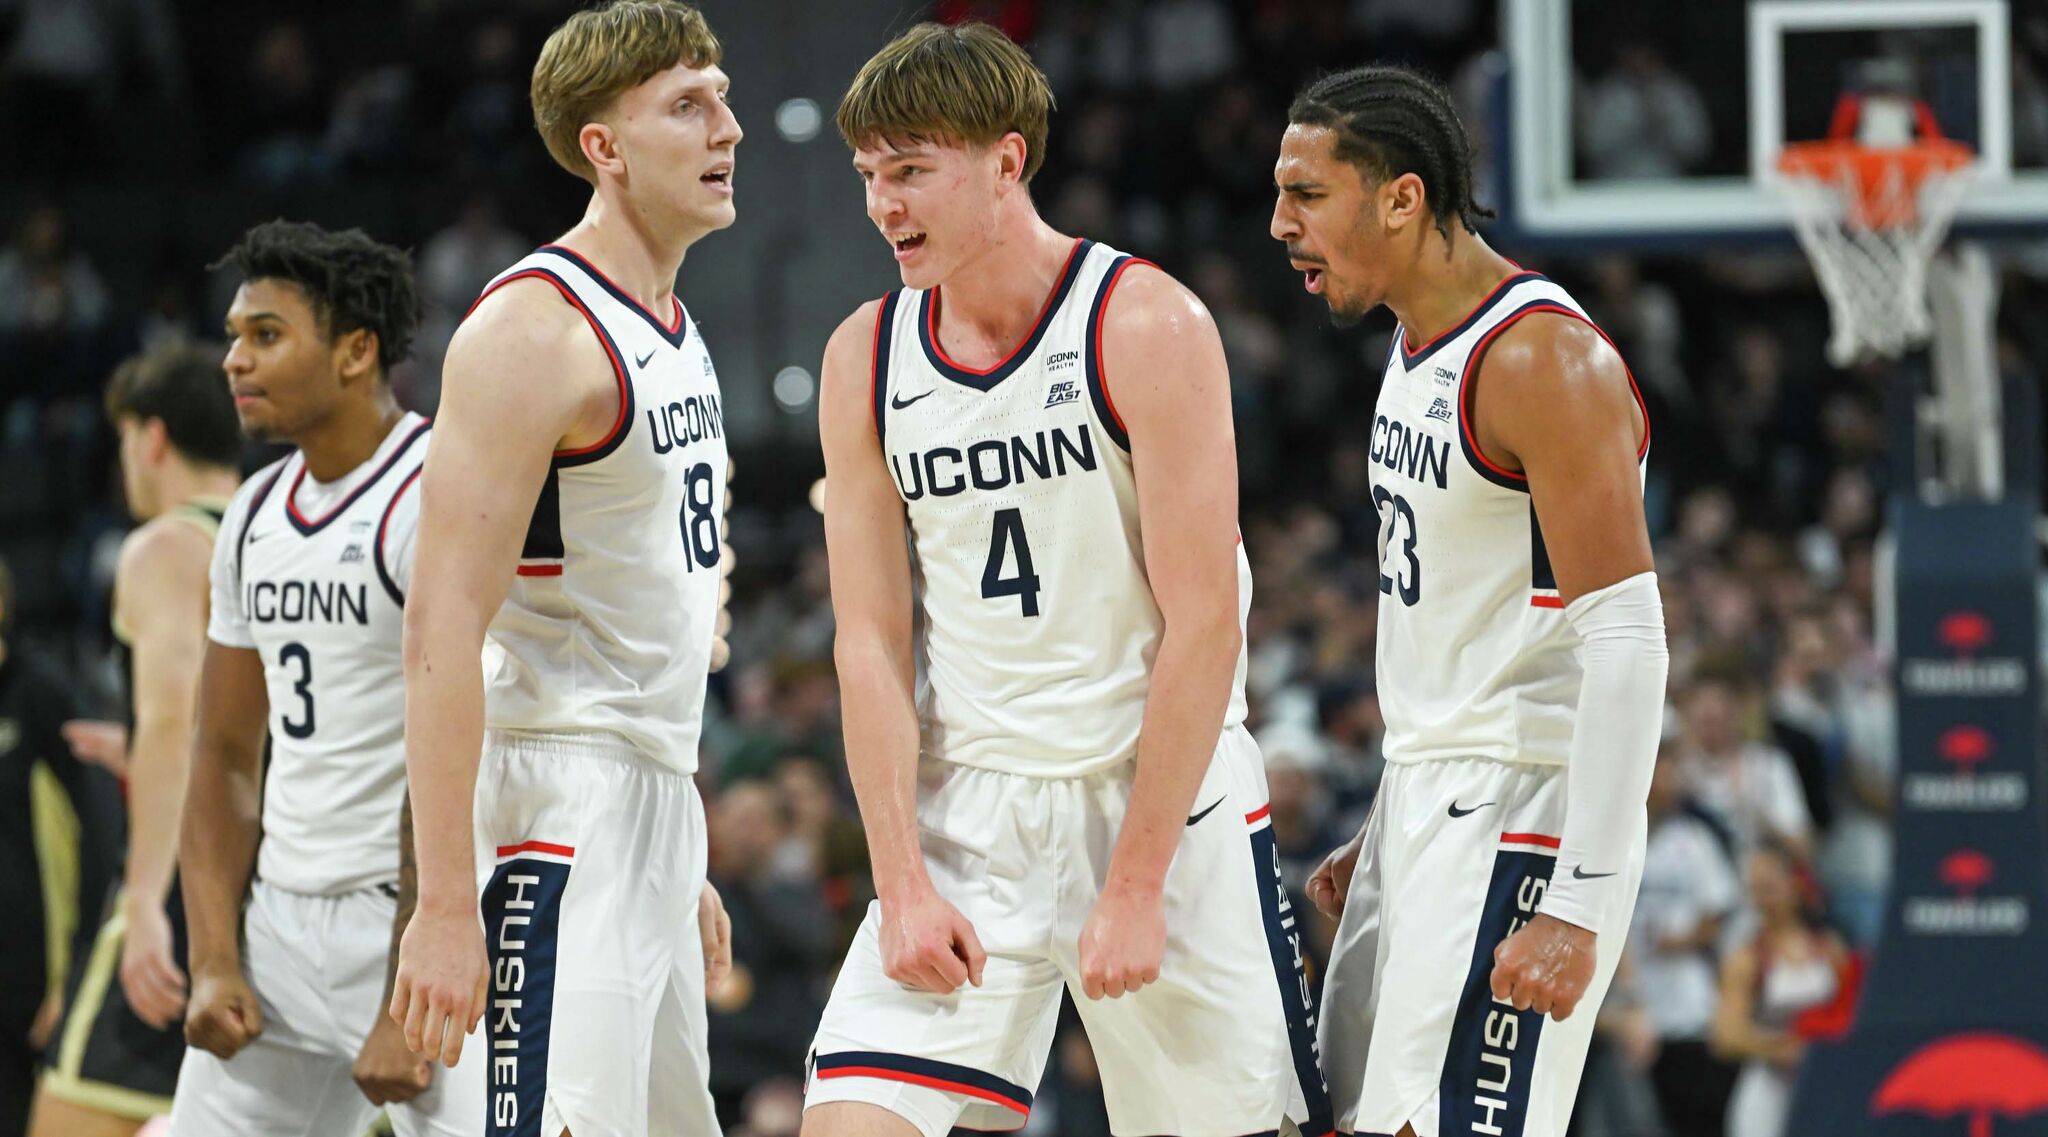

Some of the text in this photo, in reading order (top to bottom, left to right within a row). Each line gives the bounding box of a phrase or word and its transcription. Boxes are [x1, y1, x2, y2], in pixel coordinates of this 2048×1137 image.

[1047, 351, 1078, 365] UCONN
[1049, 362, 1073, 371] HEALTH
[1050, 381, 1074, 394] BIG
[1046, 390, 1081, 404] EAST
[1428, 406, 1452, 419] EAST
[1433, 397, 1448, 409] BIG
[892, 424, 1098, 501] UCONN
[1370, 412, 1451, 490] CONN
[679, 462, 721, 573] 18
[1372, 484, 1421, 607] 23
[980, 507, 1041, 618] 4
[279, 641, 316, 740] 3
[494, 873, 540, 1128] HUSKIES
[1470, 875, 1548, 1137] HUSS
